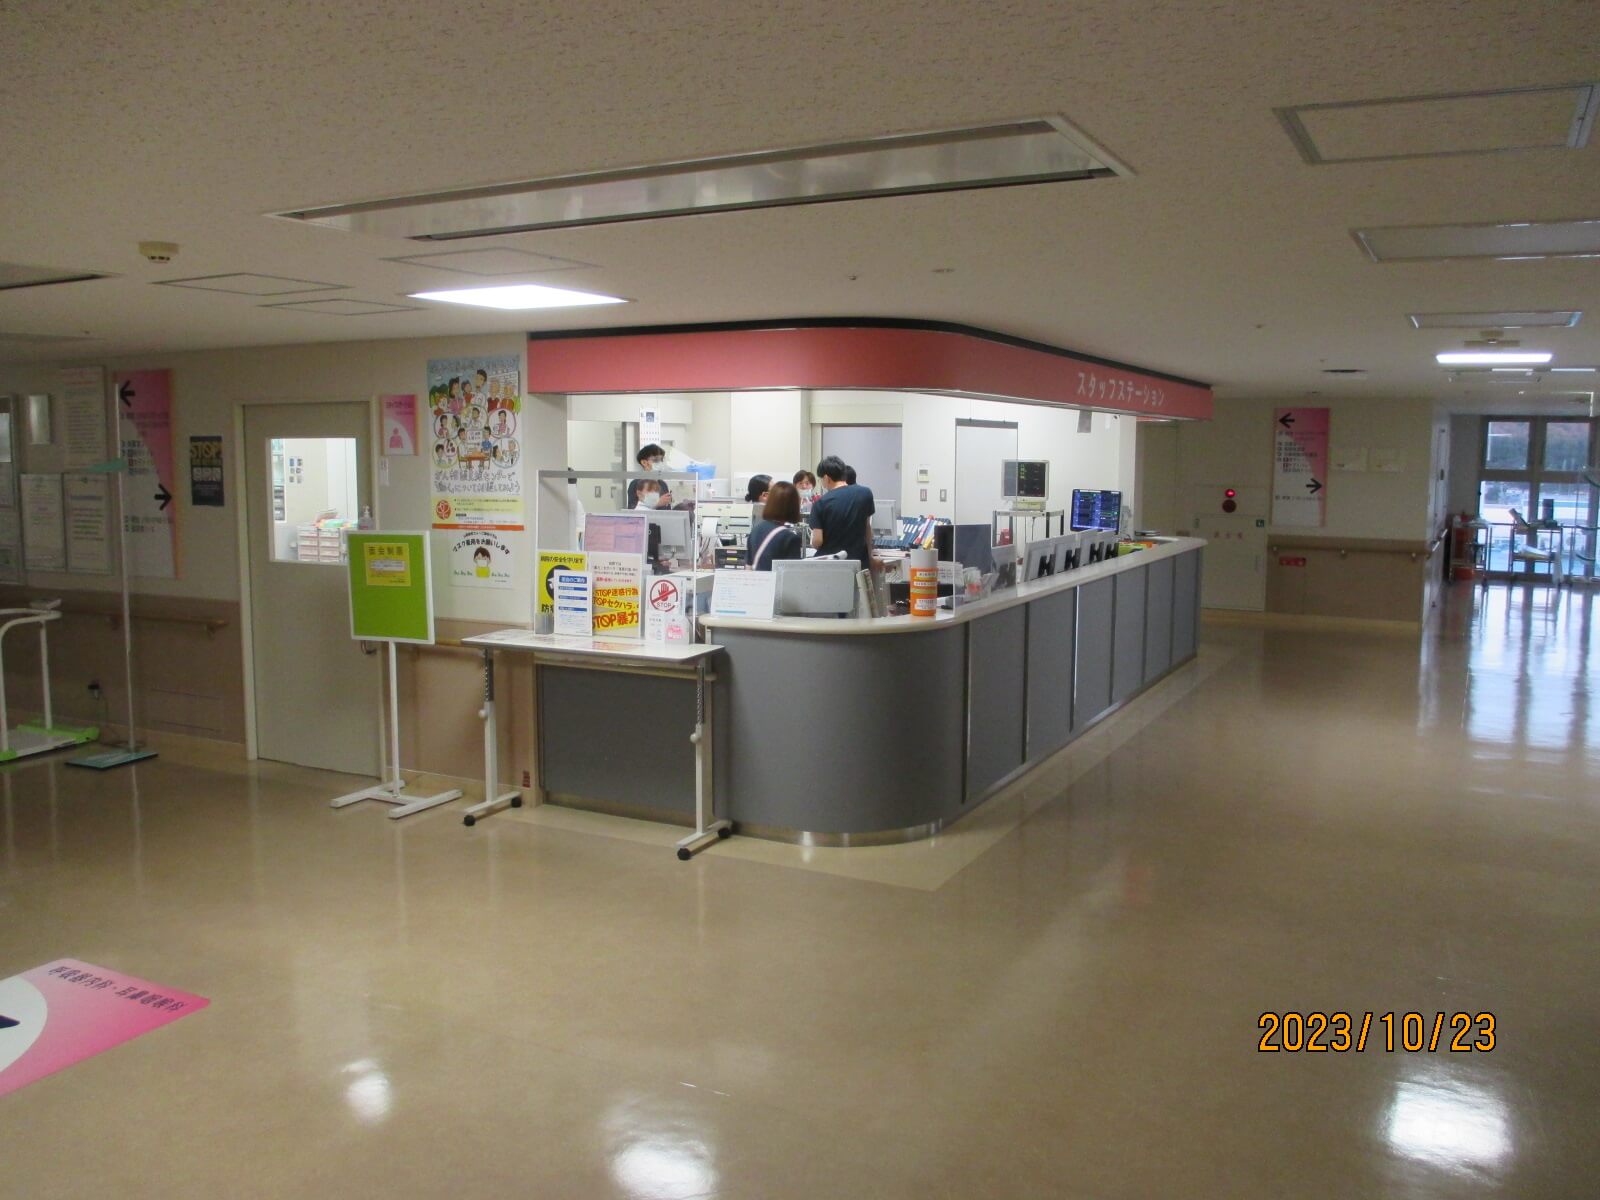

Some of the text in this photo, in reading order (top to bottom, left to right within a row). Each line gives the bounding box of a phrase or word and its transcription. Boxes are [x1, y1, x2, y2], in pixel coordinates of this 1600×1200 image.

[1078, 372, 1165, 406] スタッフステーション
